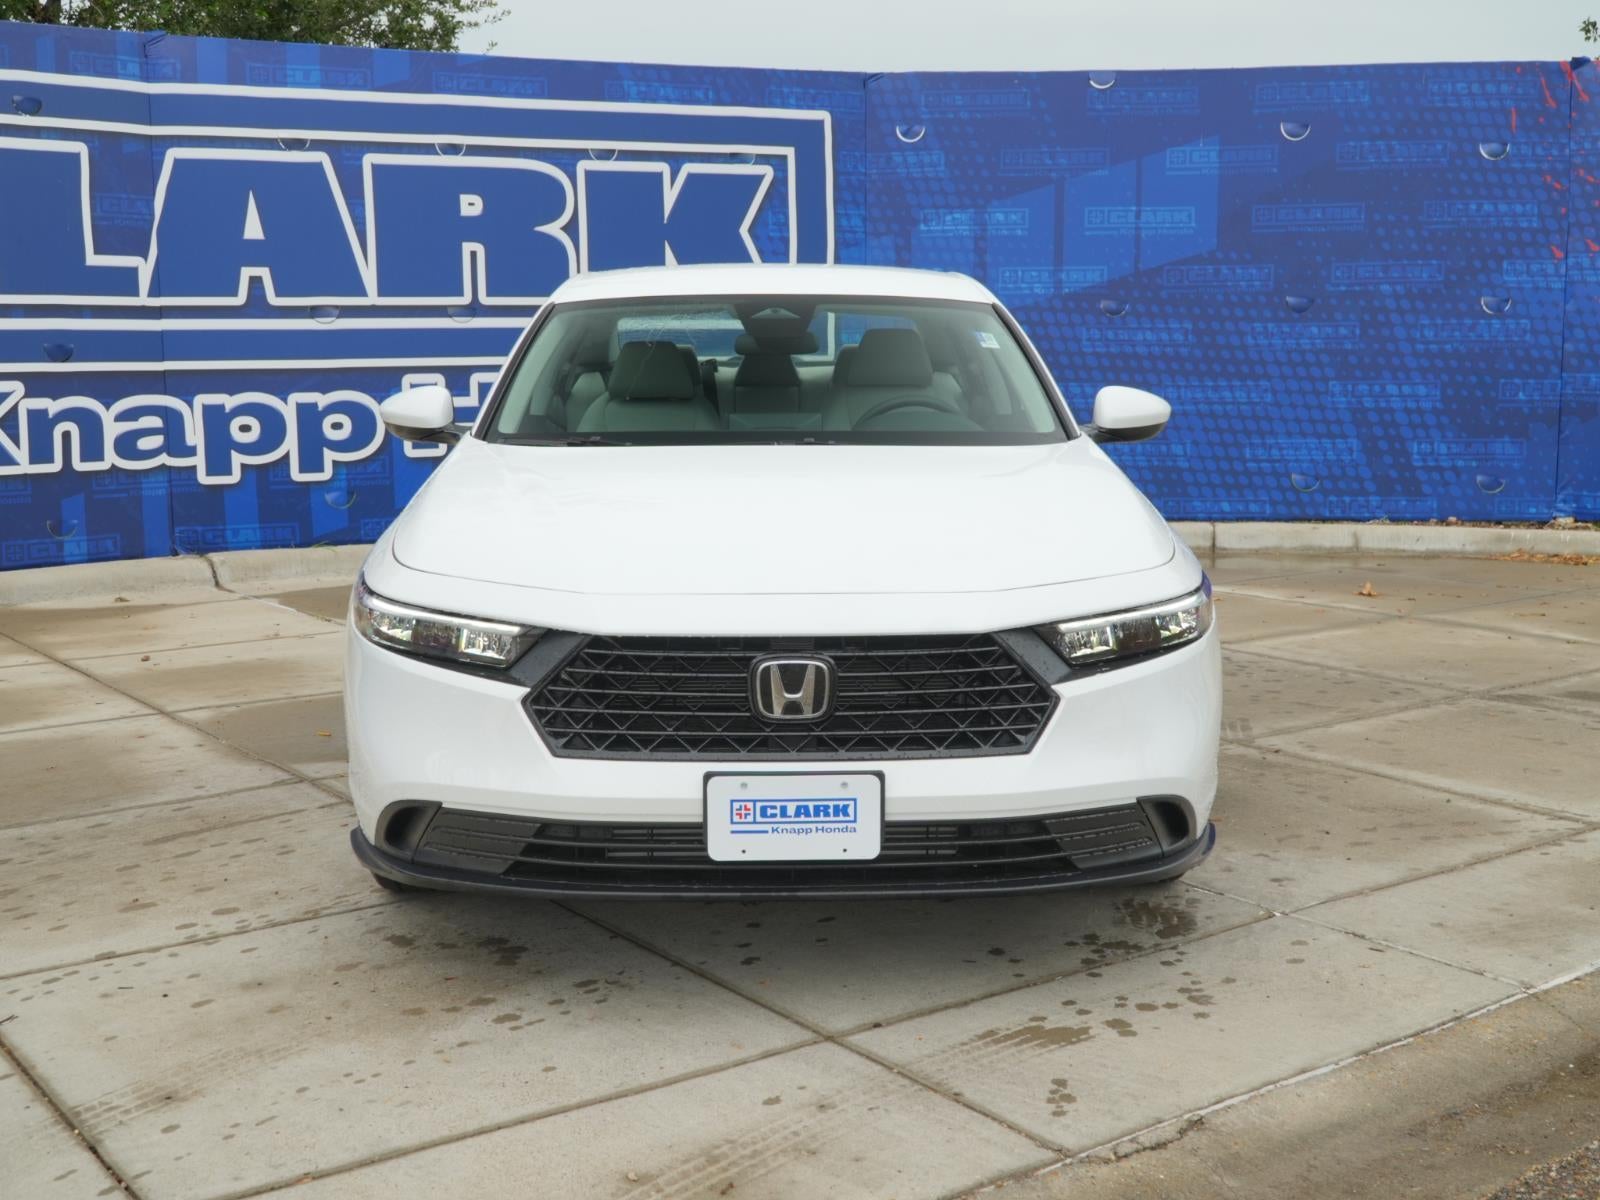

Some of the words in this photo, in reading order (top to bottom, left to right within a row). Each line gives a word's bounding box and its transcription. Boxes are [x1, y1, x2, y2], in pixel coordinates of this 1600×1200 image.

[0, 380, 385, 485] napp
[759, 803, 851, 819] CLARK
[771, 825, 813, 836] Knapp
[815, 825, 857, 834] Honda
